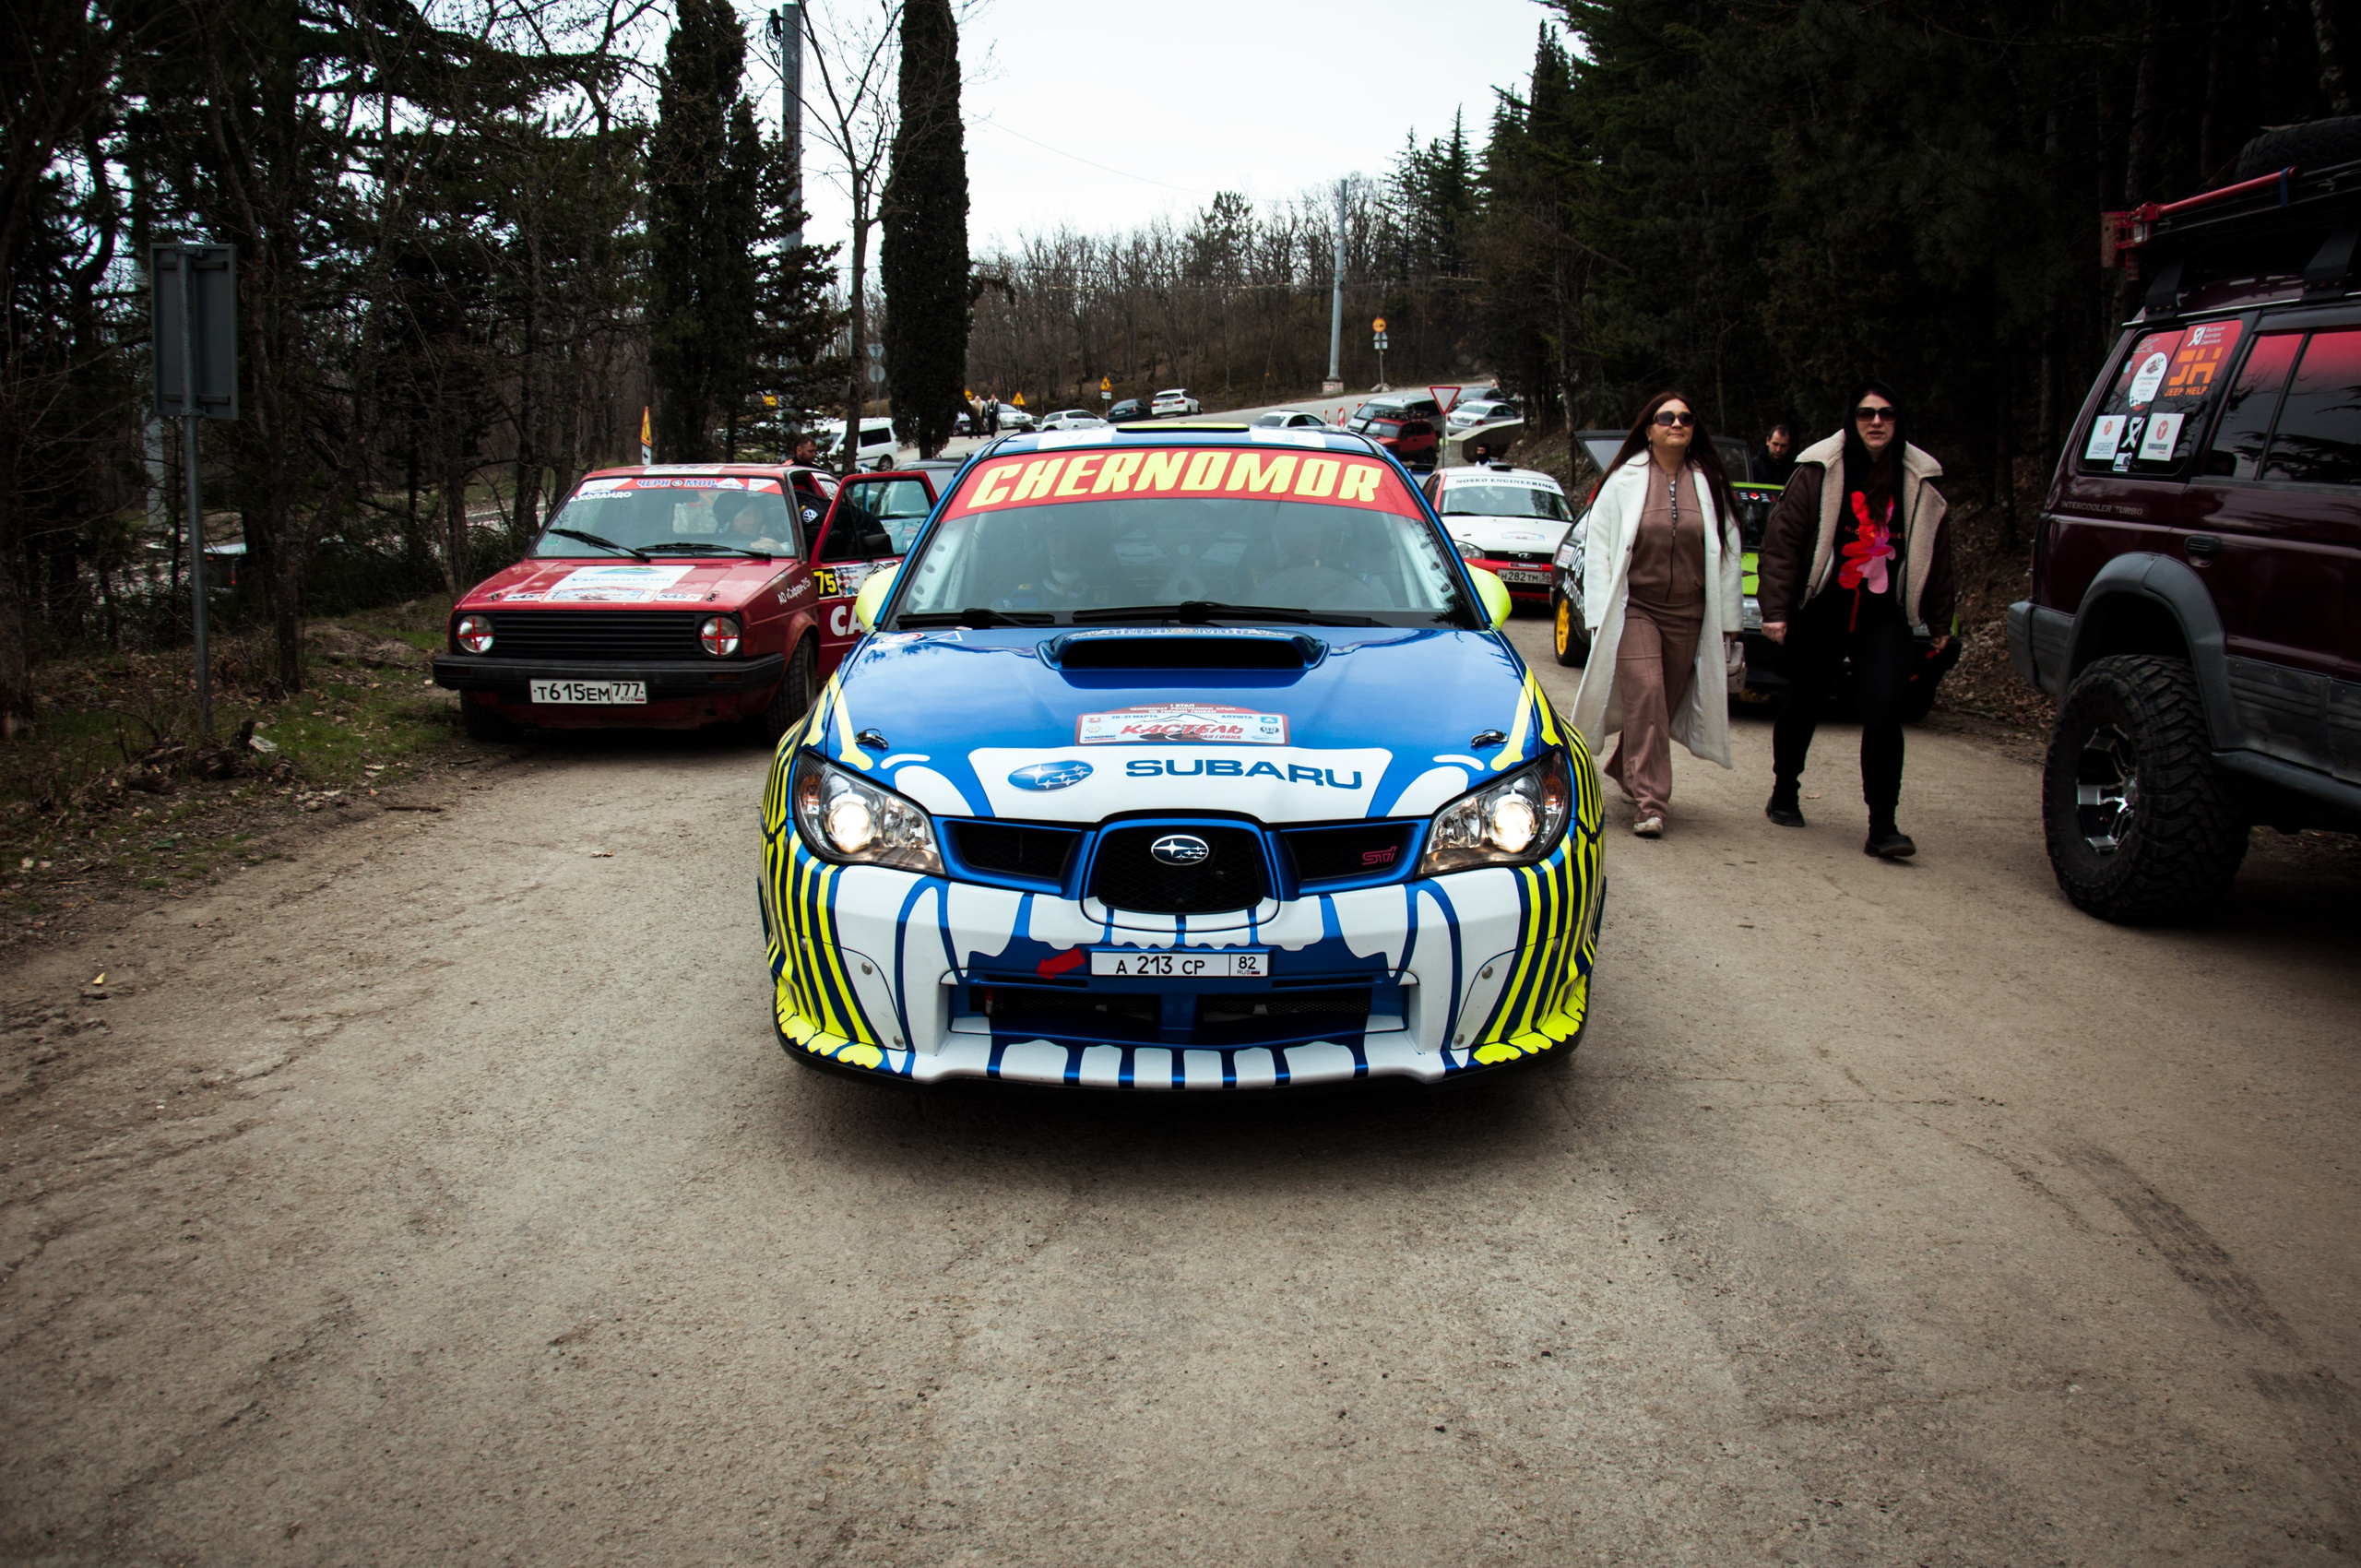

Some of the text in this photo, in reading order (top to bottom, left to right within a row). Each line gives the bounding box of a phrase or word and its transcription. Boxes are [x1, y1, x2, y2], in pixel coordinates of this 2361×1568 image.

[2164, 386, 2209, 398] JEEP HELP
[967, 451, 1382, 509] CHERNOMOR
[1490, 478, 1555, 490] ENGINEERING
[2060, 500, 2143, 516] INTERCOOLER TURBO
[813, 570, 837, 594] 75
[1541, 573, 1551, 581] 56
[537, 683, 641, 701] Т615ЕМ 777
[1120, 723, 1244, 734] КАСТЕЛЬ
[1125, 759, 1362, 790] SUBARU
[1136, 956, 1173, 975] 213
[1238, 956, 1257, 969] 82
